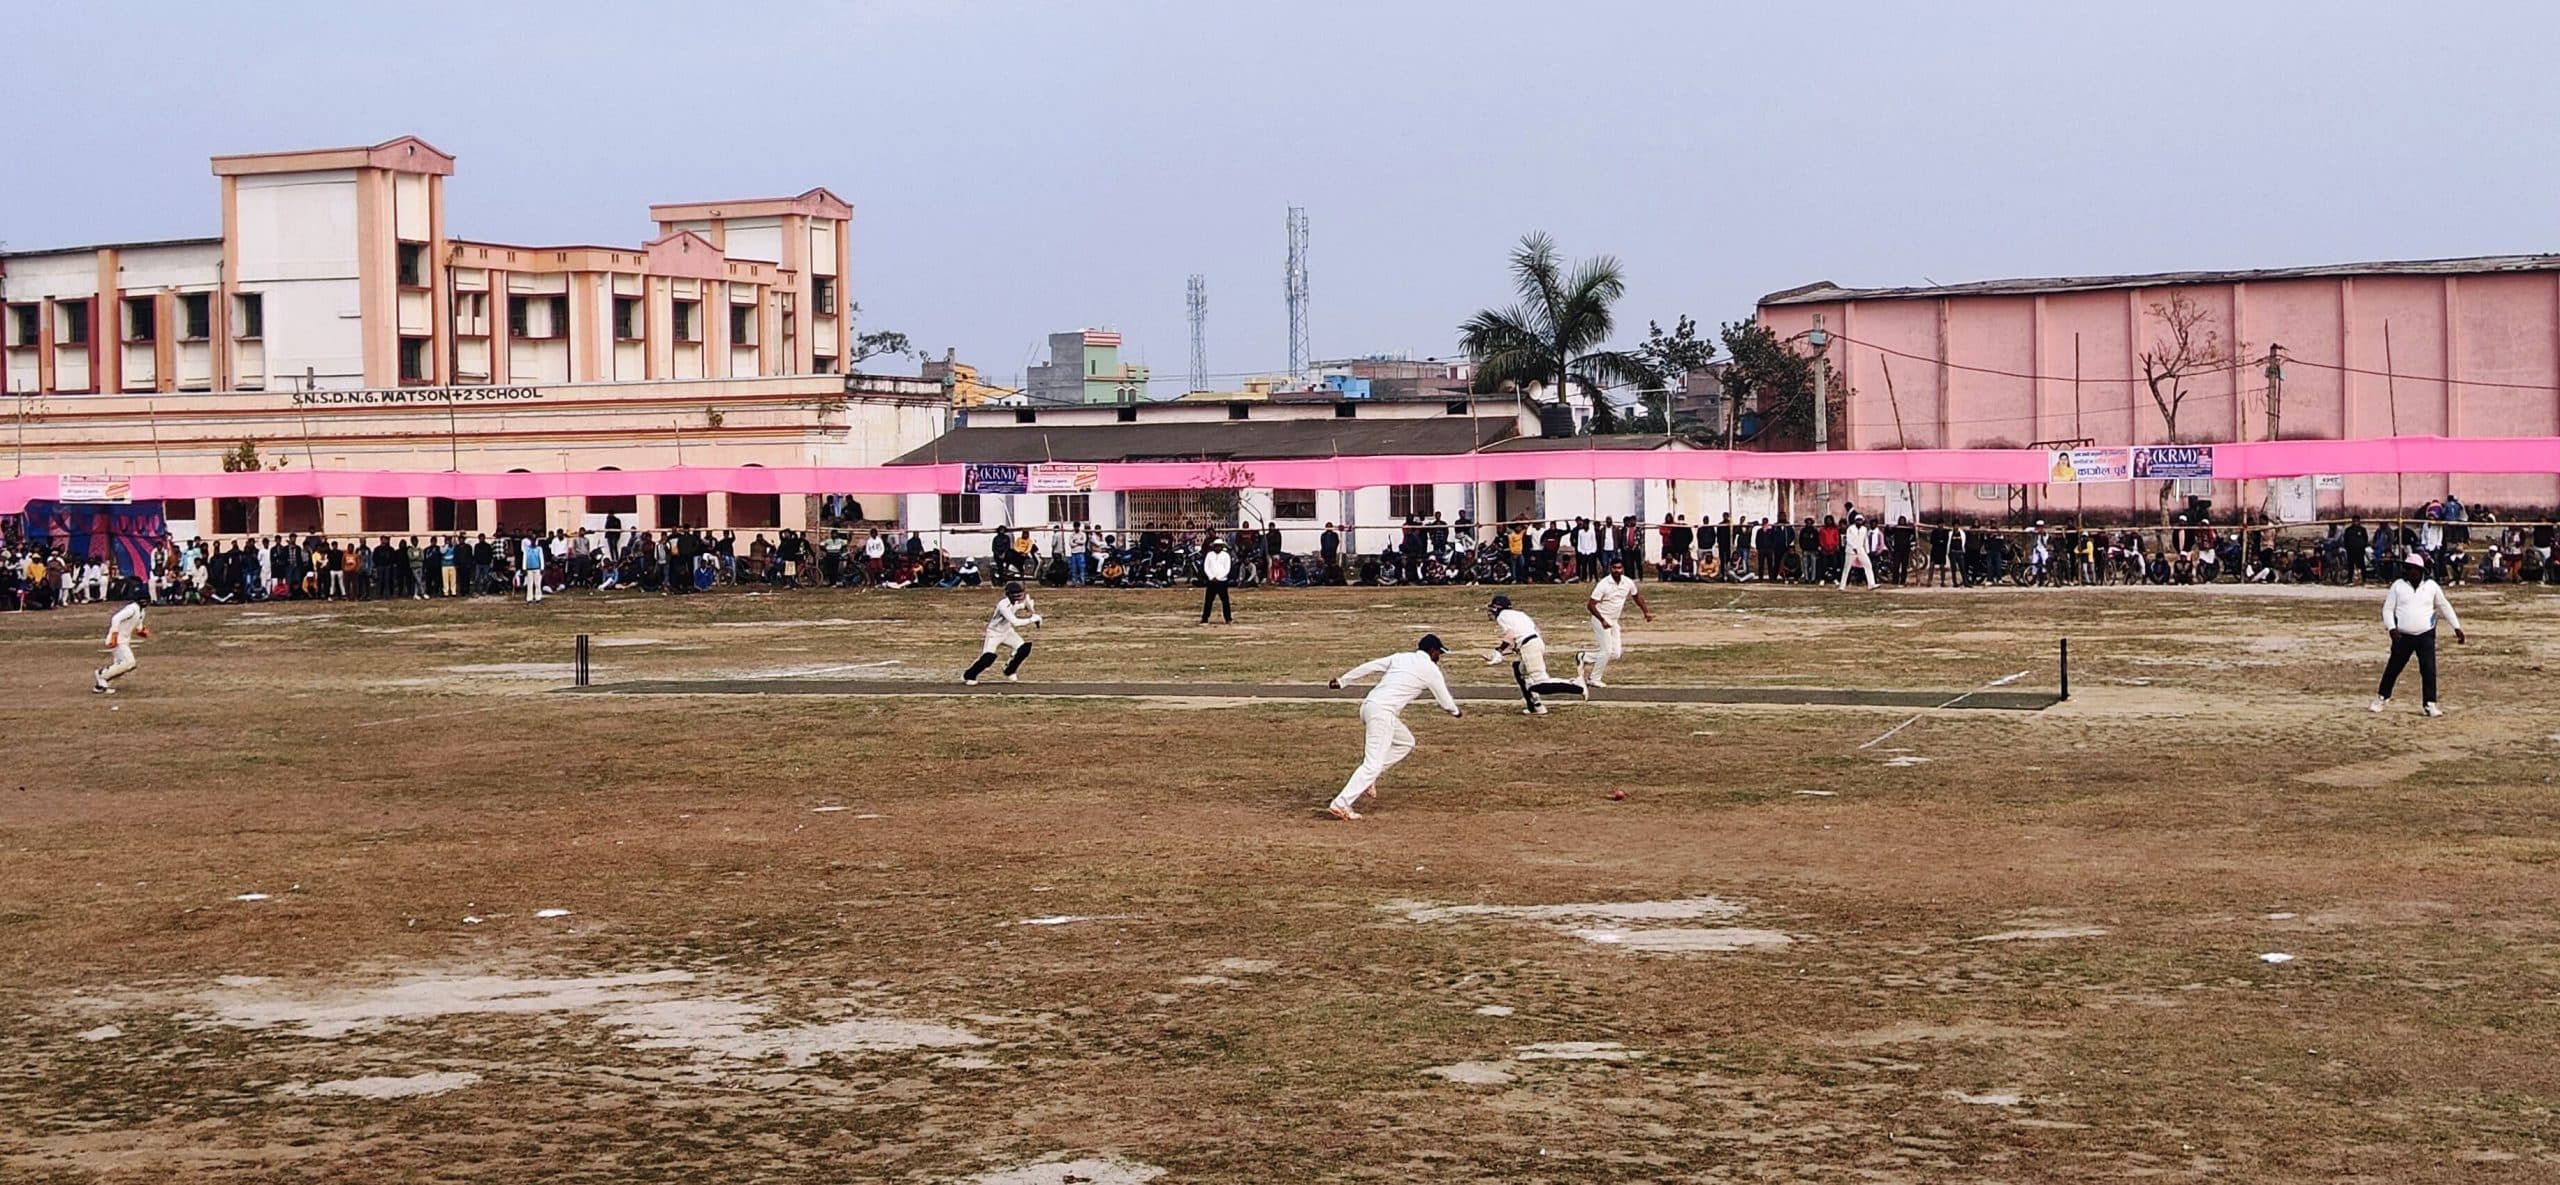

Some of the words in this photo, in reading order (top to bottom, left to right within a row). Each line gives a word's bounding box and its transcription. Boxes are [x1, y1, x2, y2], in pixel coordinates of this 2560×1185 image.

[381, 390, 450, 402] WATSON
[476, 388, 543, 400] SCHOOL
[2153, 449, 2197, 465] (KRM)
[980, 467, 1016, 480] (KRM)
